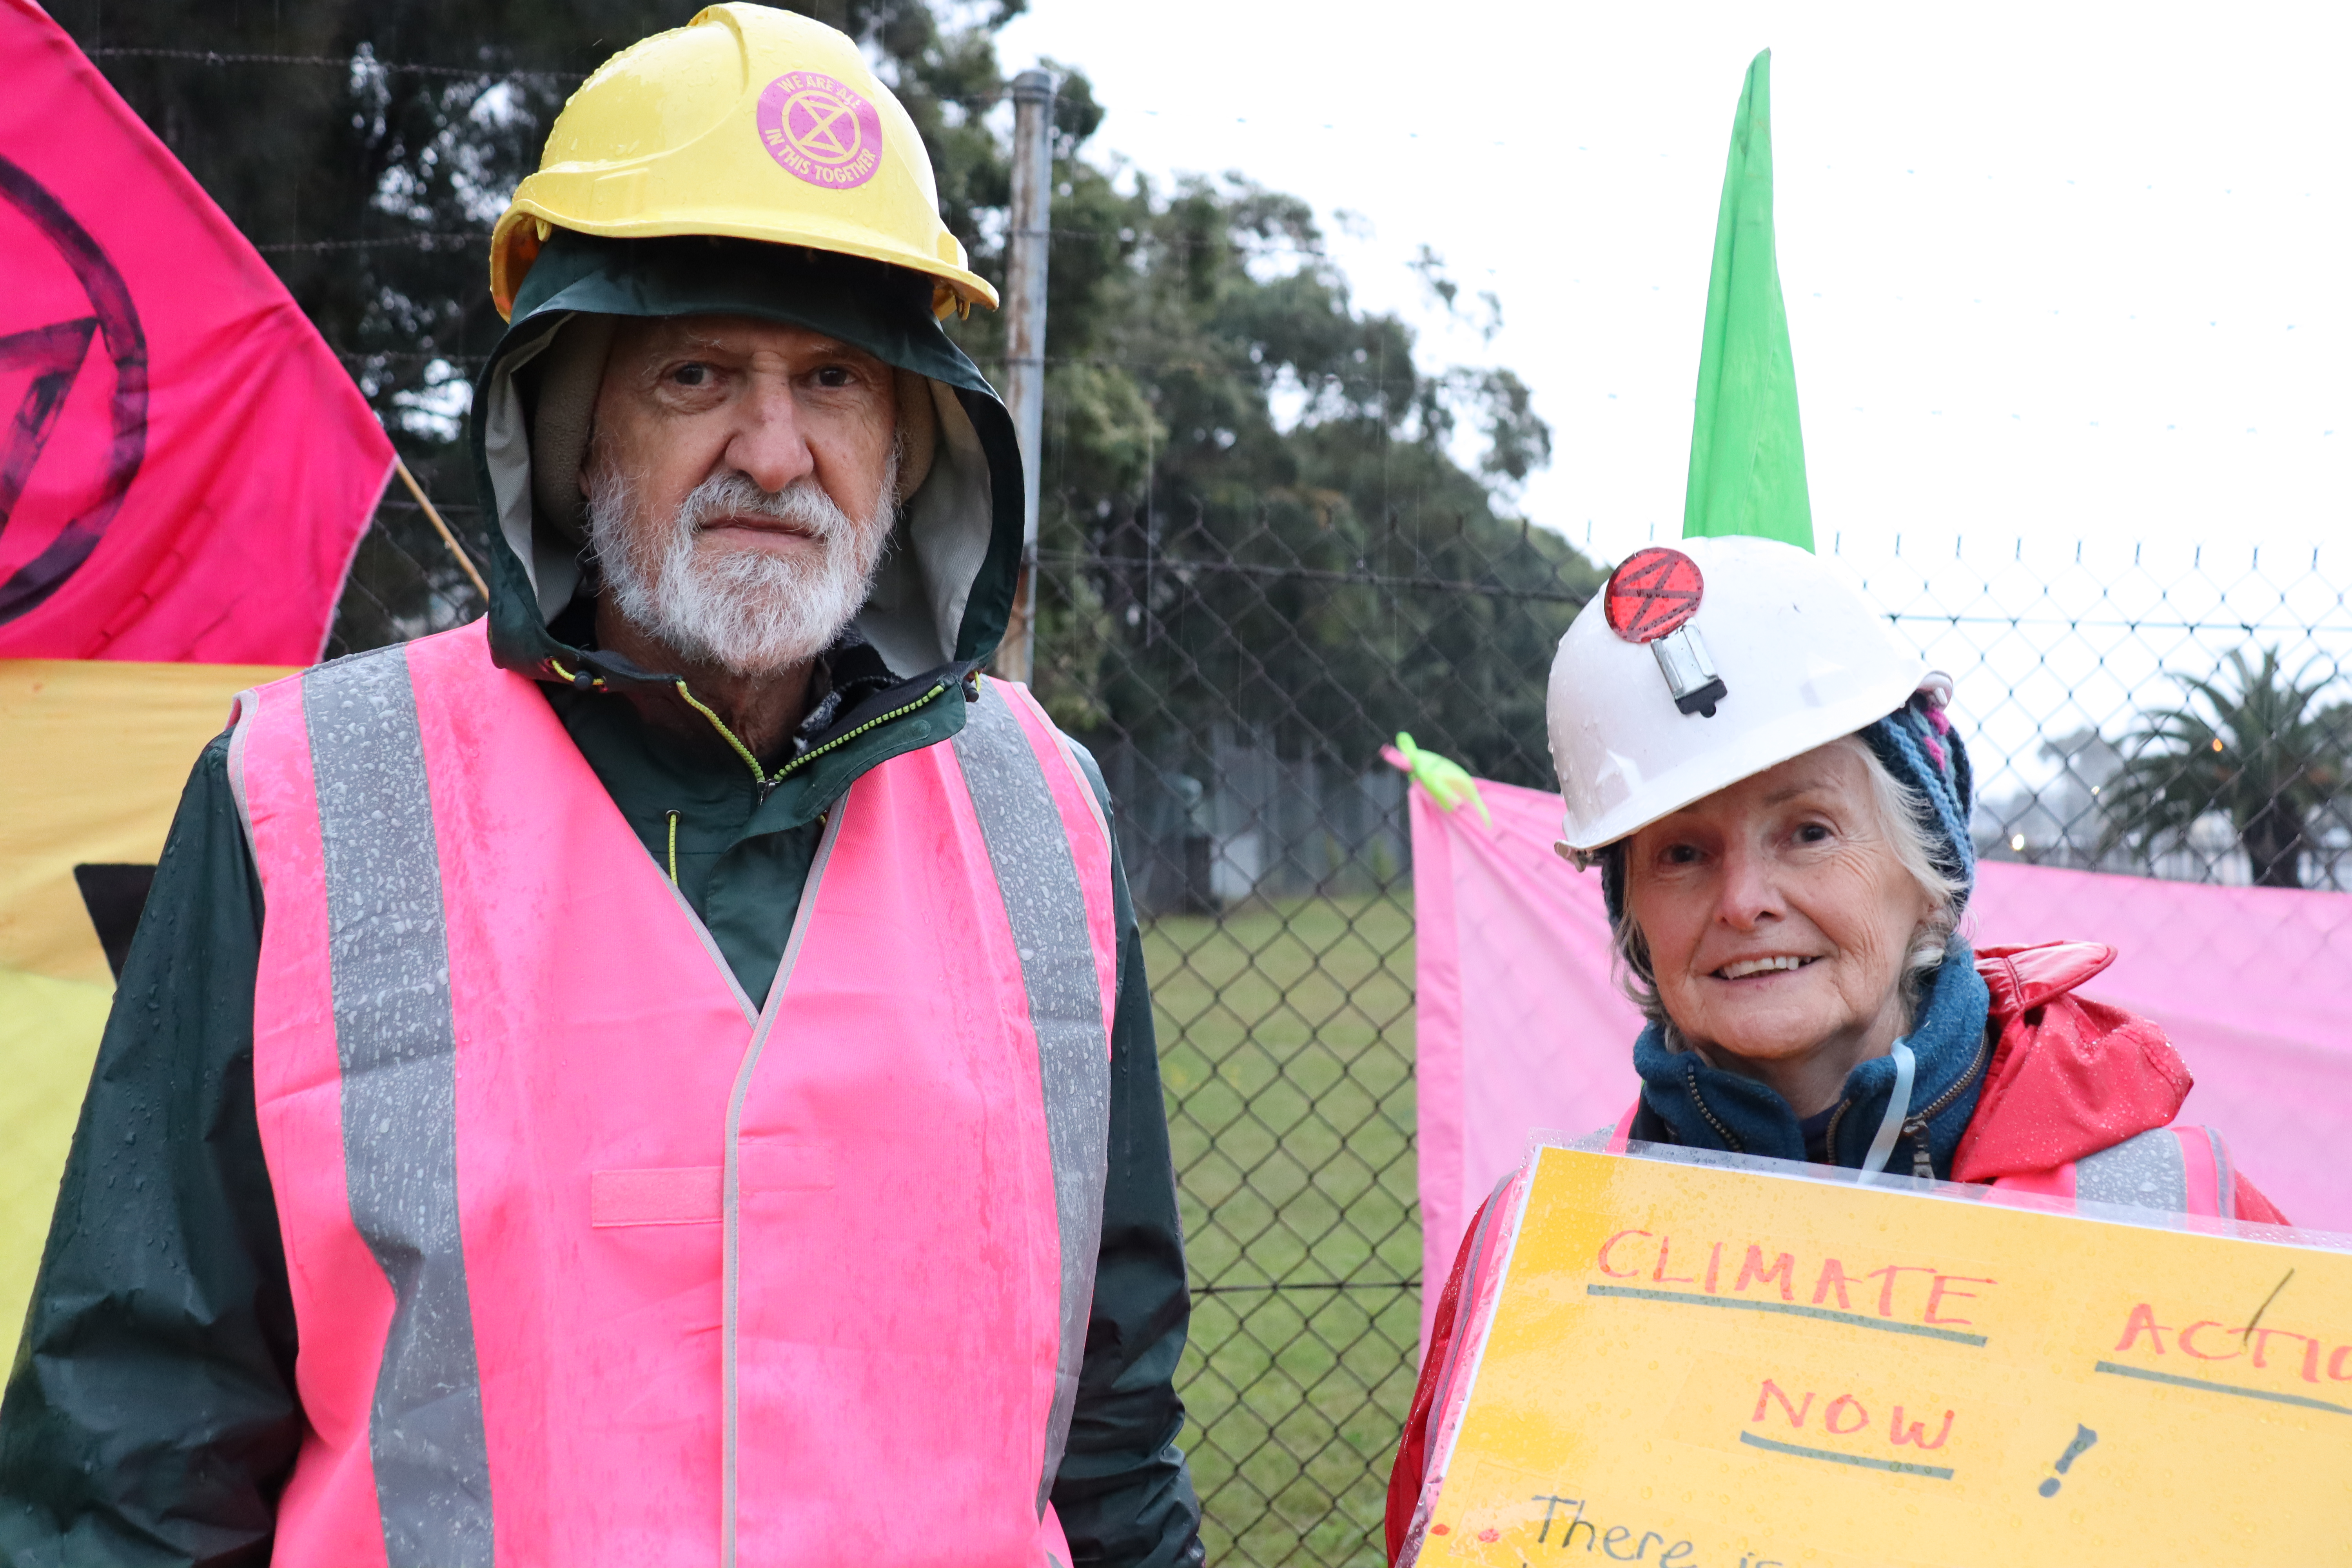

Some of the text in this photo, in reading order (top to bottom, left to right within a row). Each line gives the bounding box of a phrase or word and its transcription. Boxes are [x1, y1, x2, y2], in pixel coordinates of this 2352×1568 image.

[777, 75, 862, 108] WE ARE ALL
[765, 128, 876, 183] IN THIS TOGETHER
[1597, 1229, 1998, 1325] CLIMATE
[1751, 1378, 1955, 1450] NOW
